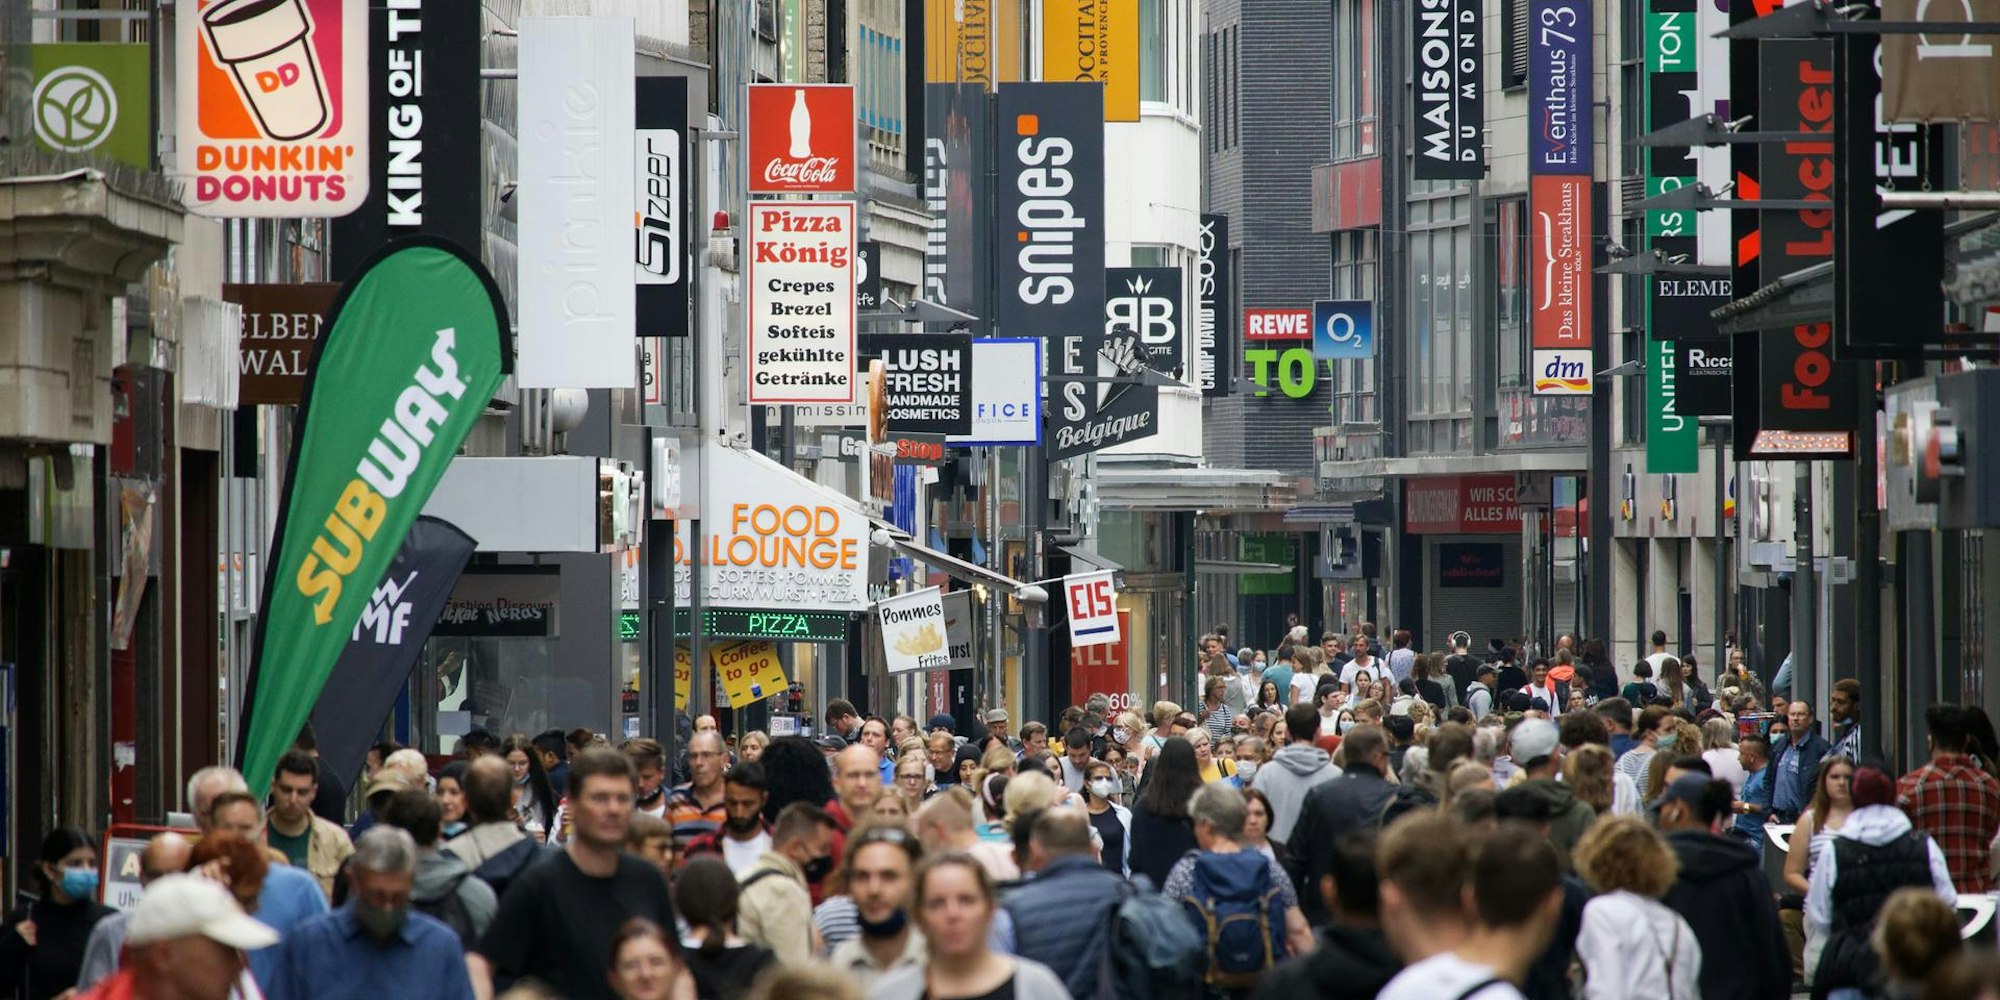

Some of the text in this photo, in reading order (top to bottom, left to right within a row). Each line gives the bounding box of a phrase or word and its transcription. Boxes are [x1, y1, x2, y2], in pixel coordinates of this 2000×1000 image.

[255, 62, 300, 93] DD
[388, 49, 413, 97] OF
[1460, 10, 1476, 161] DU MOND
[1540, 6, 1577, 164] Eventhaus 73
[196, 145, 355, 171] DUNKIN'
[387, 104, 423, 225] KING
[1569, 145, 1577, 164] Hohe
[1785, 61, 1834, 256] Locker
[197, 175, 347, 202] DONUTS
[535, 79, 616, 326] pimkie
[761, 211, 842, 233] Pizza
[1017, 137, 1086, 304] snipes
[755, 242, 848, 269] König
[1558, 182, 1573, 339] Das kleine Steakhaus
[1575, 250, 1583, 272] KÖLN
[768, 278, 835, 296] Crepes
[770, 302, 832, 316] Brezel
[767, 325, 836, 339] Softeis
[1200, 308, 1215, 348] DAVID
[1250, 314, 1308, 335] REWE
[758, 348, 845, 365] gekühlte
[881, 349, 960, 371] LUSH
[1545, 356, 1584, 378] dm
[1780, 321, 1831, 410] Foo
[755, 372, 848, 386] Getränke
[887, 373, 960, 392] FRESH
[1200, 351, 1215, 390] CAMP
[1055, 410, 1150, 450] Belgique
[296, 328, 467, 626] SUBWAY
[1470, 488, 1494, 502] WIR
[732, 504, 840, 537] FOOD
[1464, 507, 1503, 522] ALLES
[714, 534, 858, 570] LOUNGE
[718, 570, 853, 588] SOFTEIS POMMES
[709, 584, 861, 604] CURRYWURST PIZZA
[1069, 580, 1113, 620] EIS
[352, 571, 418, 645] WMF
[881, 603, 941, 625] Pommes
[749, 615, 809, 634] PIZZA
[720, 642, 769, 667] Coffee
[918, 654, 949, 668] Frites
[725, 658, 769, 681] to go
